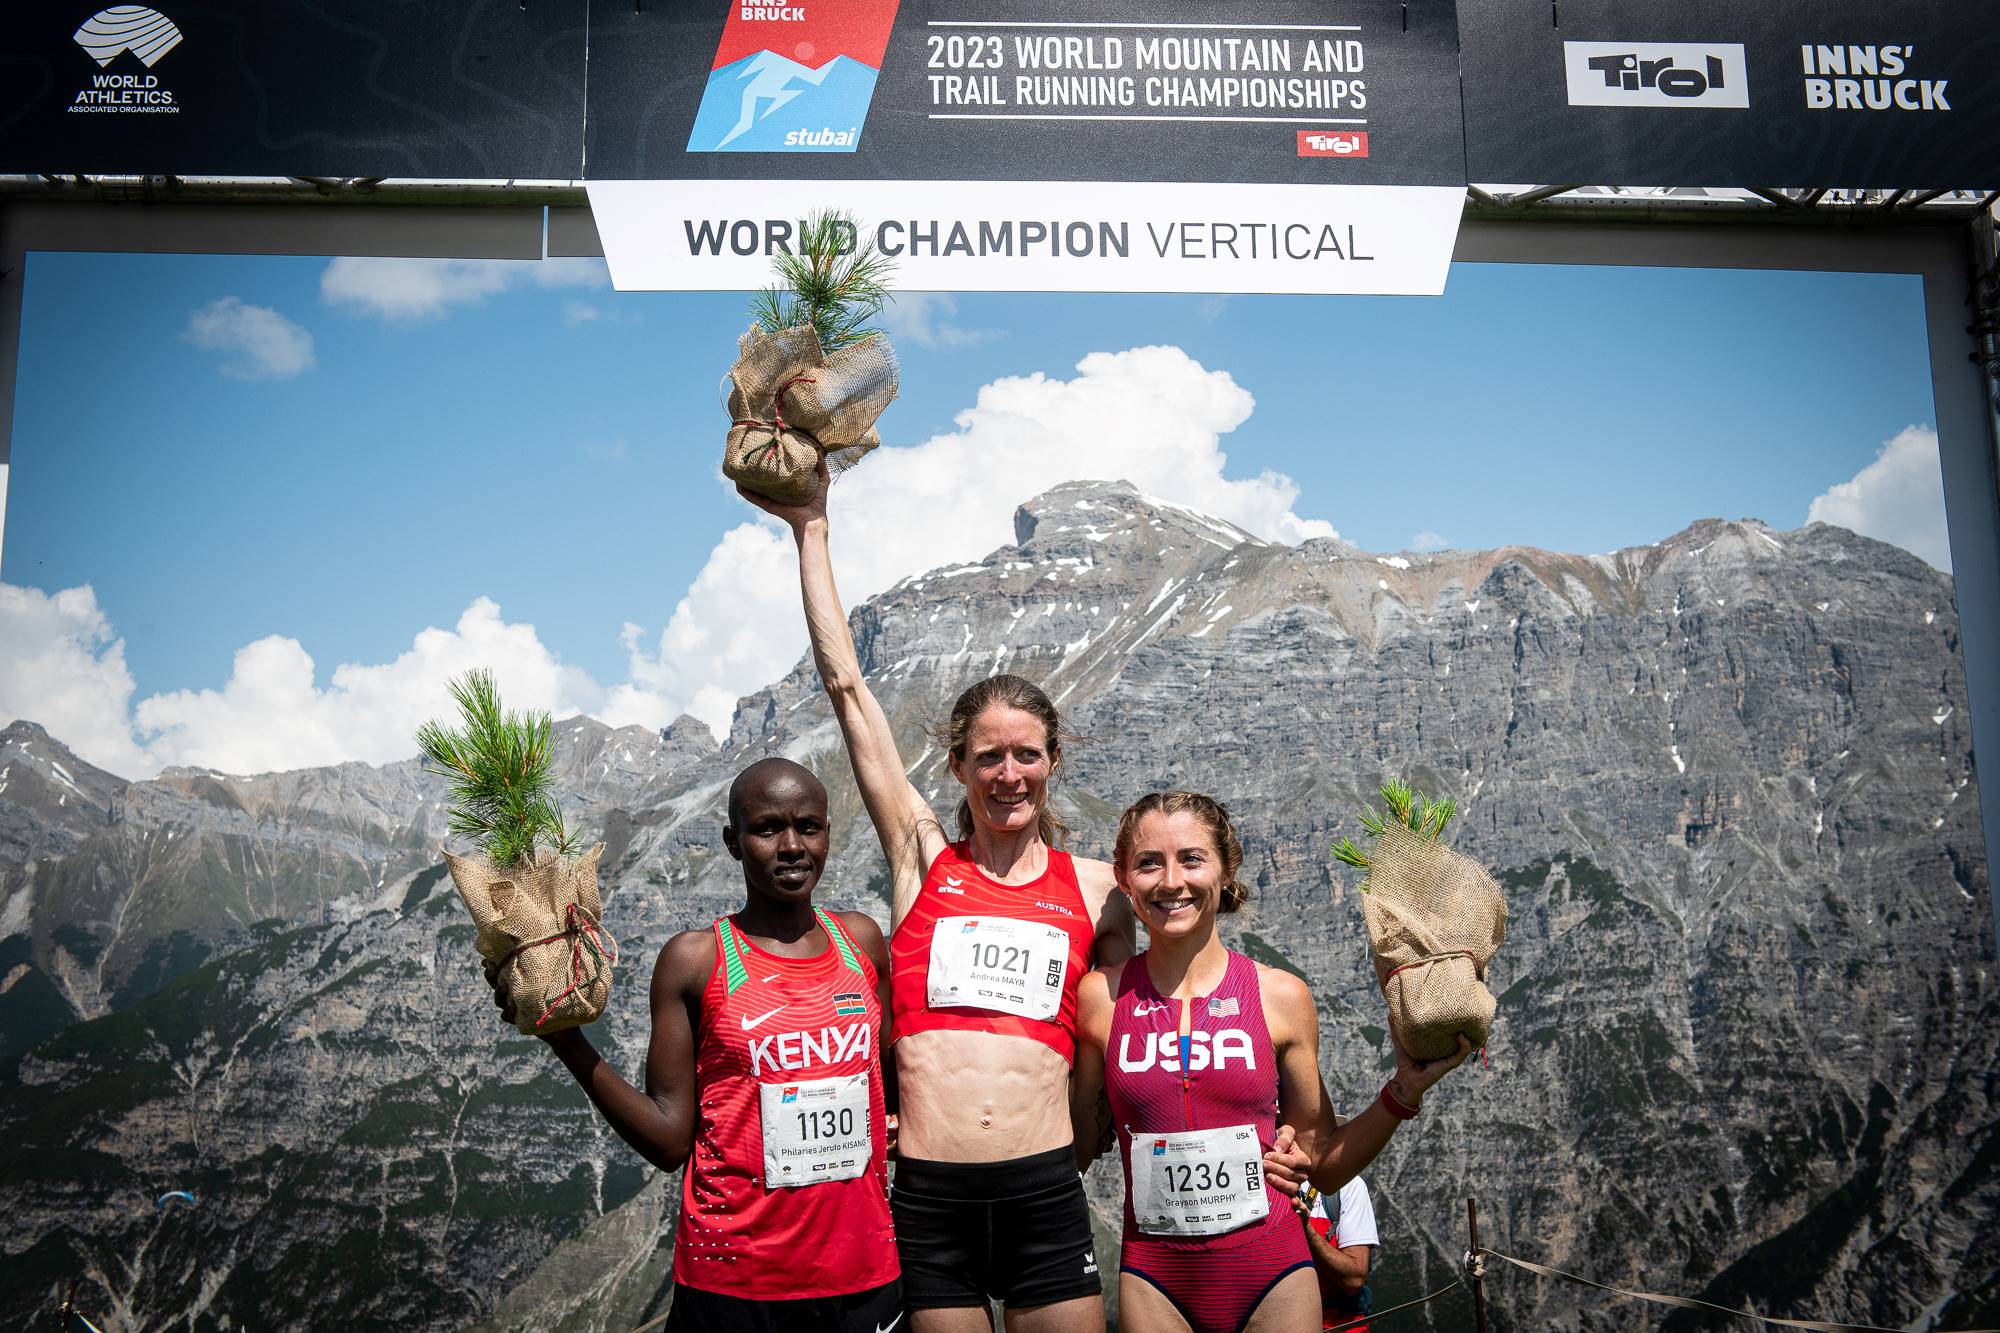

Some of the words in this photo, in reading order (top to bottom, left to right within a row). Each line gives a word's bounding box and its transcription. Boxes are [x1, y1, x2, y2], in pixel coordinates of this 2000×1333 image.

[741, 7, 805, 21] BRUCK
[927, 35, 1004, 68] 2023
[1014, 36, 1123, 69] WORLD
[1136, 37, 1291, 72] MOUNTAIN
[1303, 39, 1364, 73] AND
[1801, 44, 1913, 76] INNS'
[93, 75, 158, 88] WORLD
[1588, 53, 1725, 97] Tirol
[75, 90, 173, 104] ATHLETICS
[928, 75, 1006, 105] TRAIL
[1016, 76, 1135, 106] RUNNING
[1145, 77, 1367, 110] CHAMPIONSHIPS
[1805, 78, 1951, 110] BRUCK
[784, 127, 857, 146] stubai
[1306, 135, 1360, 154] Tirol
[683, 219, 858, 256] WORLD
[877, 220, 1129, 258] CHAMPION
[1146, 222, 1375, 261] VERTICAL
[938, 885, 965, 895] erima
[1035, 900, 1074, 917] AUSTRIA
[1046, 931, 1061, 939] AUT
[972, 943, 1030, 974] 1021
[970, 971, 1000, 982] Andrea
[1001, 976, 1025, 988] MAYR
[748, 1023, 871, 1077] KENYA
[1118, 1028, 1256, 1073] USA
[797, 1107, 853, 1141] 1130
[1236, 1132, 1250, 1140] USA
[781, 1146, 817, 1157] Philaries
[818, 1144, 841, 1154] Jeruto
[1164, 1160, 1231, 1192] 1236
[1165, 1198, 1199, 1208] Grayson
[1200, 1193, 1237, 1205] MURPHY
